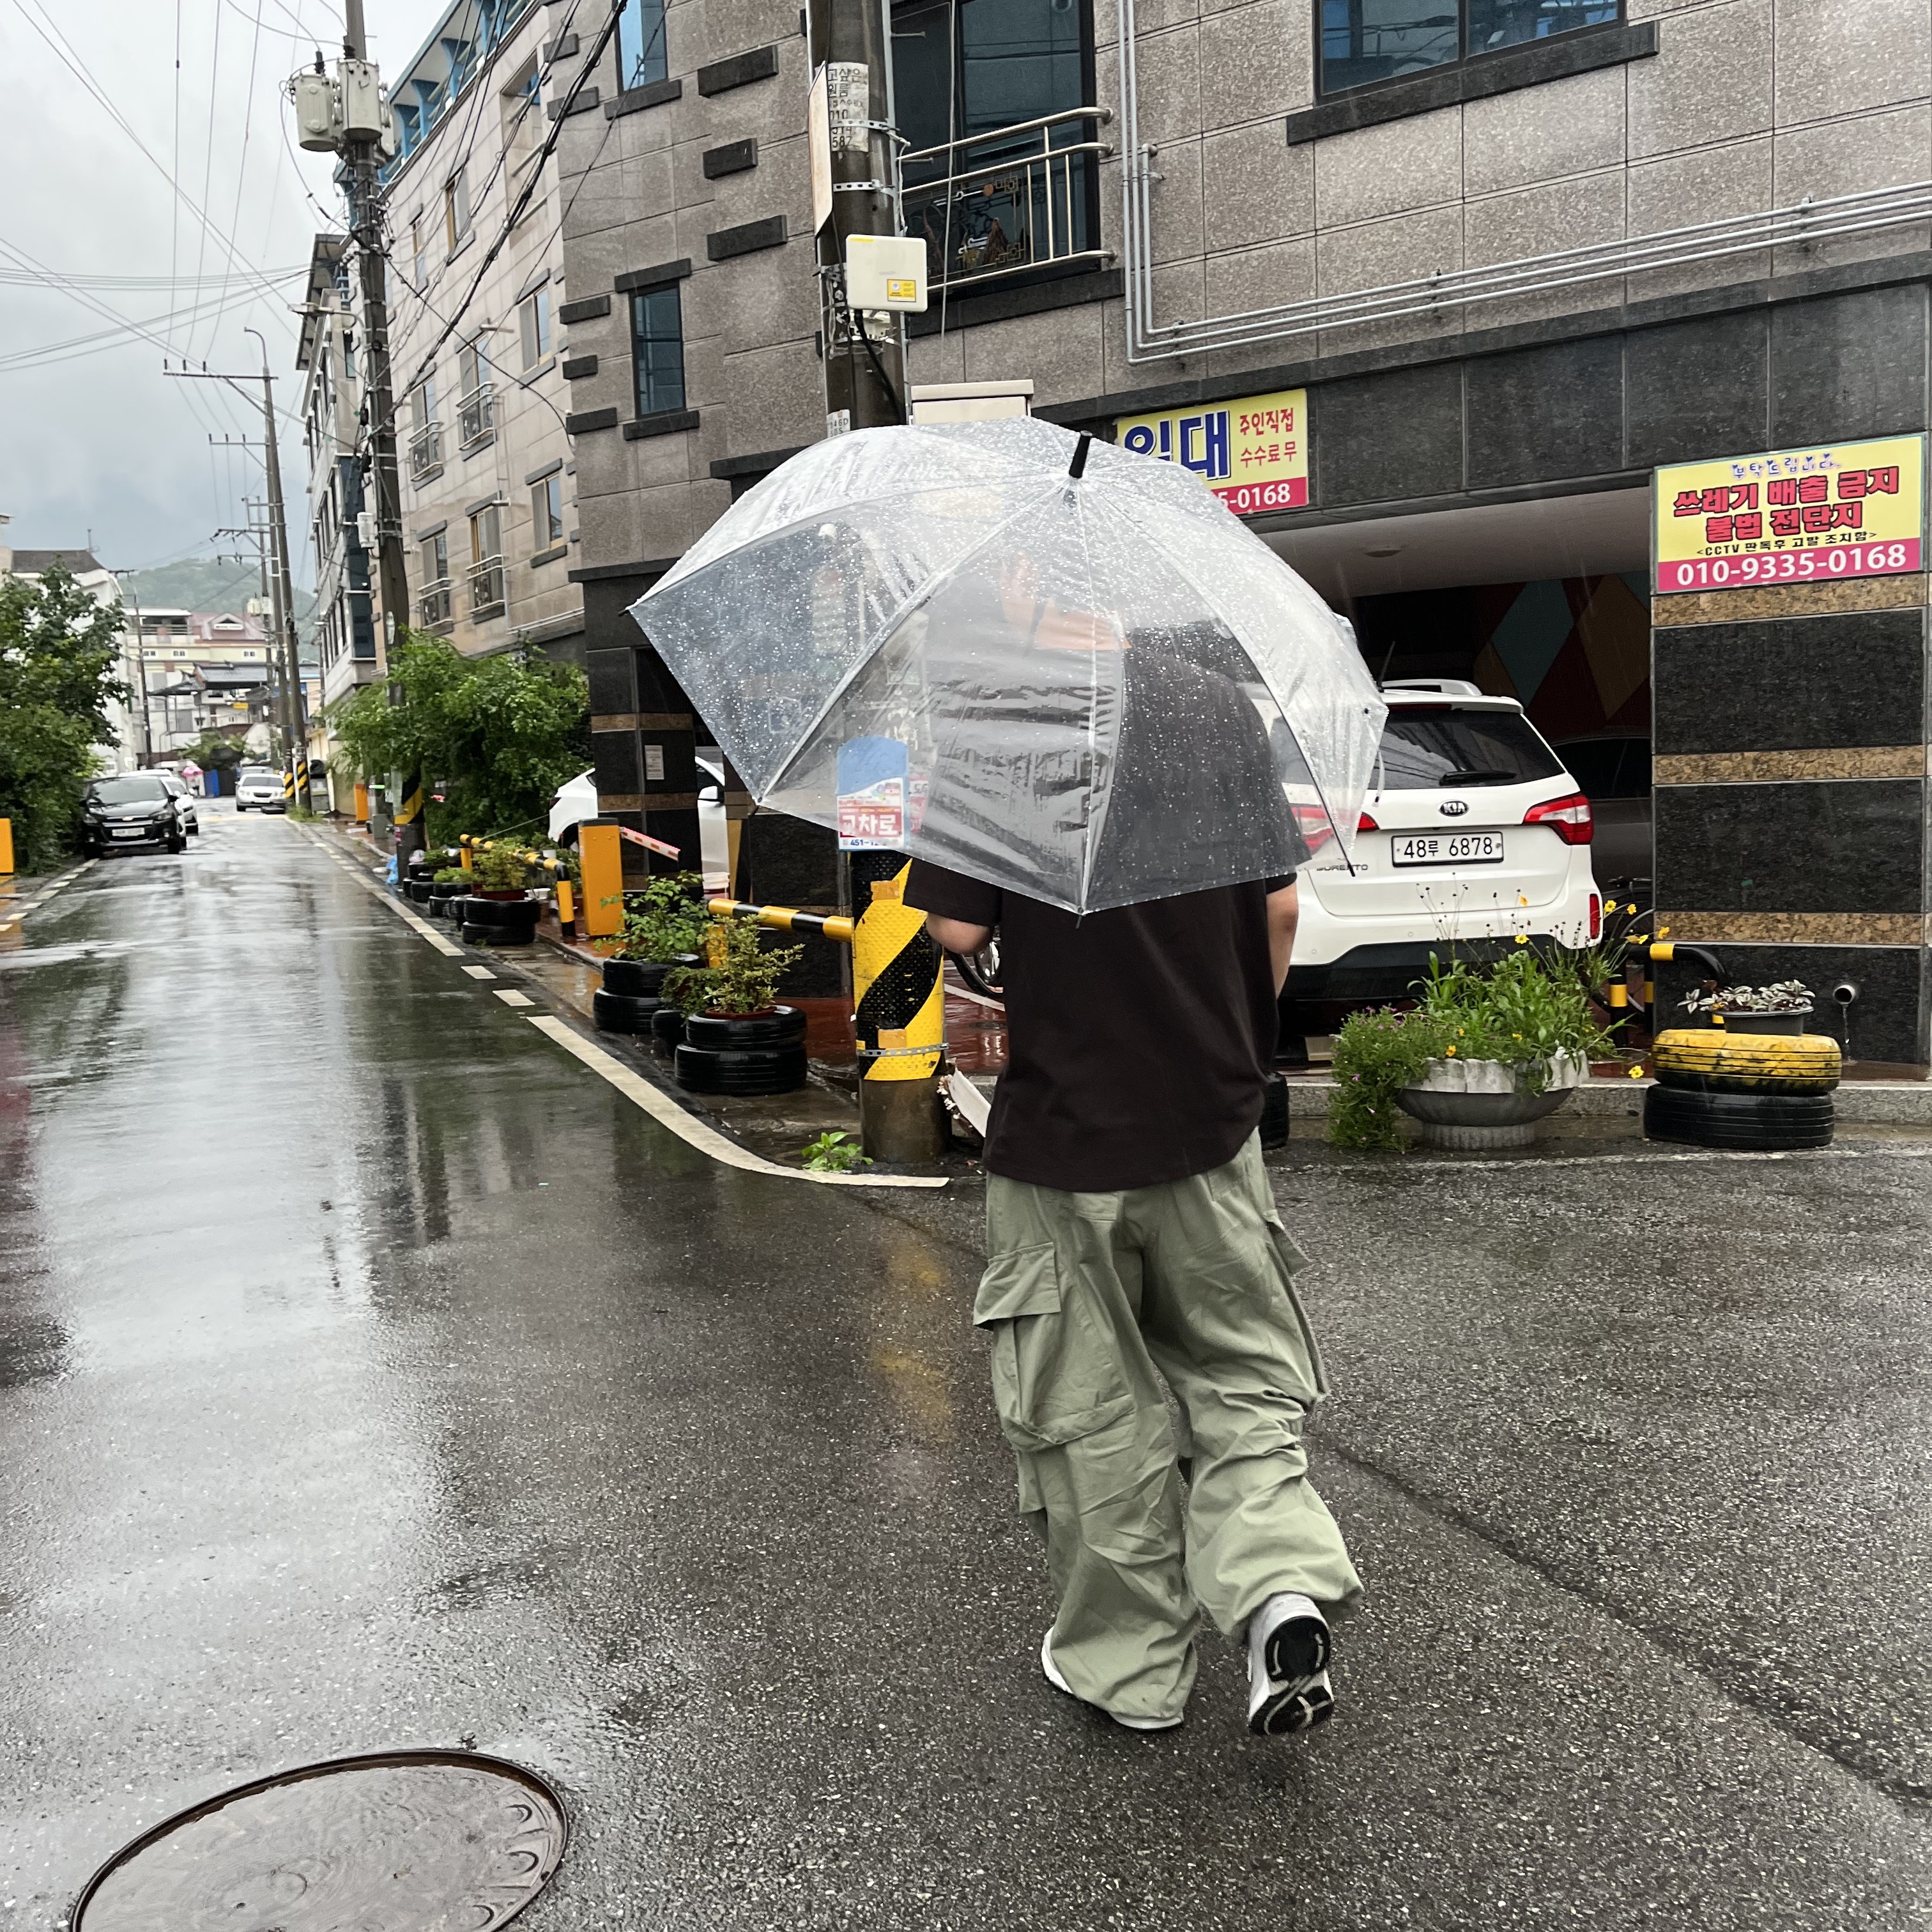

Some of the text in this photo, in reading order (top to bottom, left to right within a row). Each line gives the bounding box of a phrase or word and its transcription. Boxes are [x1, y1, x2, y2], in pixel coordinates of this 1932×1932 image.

[1239, 407, 1294, 436] 주인직접
[1673, 466, 1899, 517] 쓰레기 배출 금지
[1705, 501, 1862, 543] 불법 전단지
[1676, 544, 1906, 586] 010-9335-0168
[1443, 802, 1465, 813] KIA
[1404, 836, 1492, 858] 48루 6878
